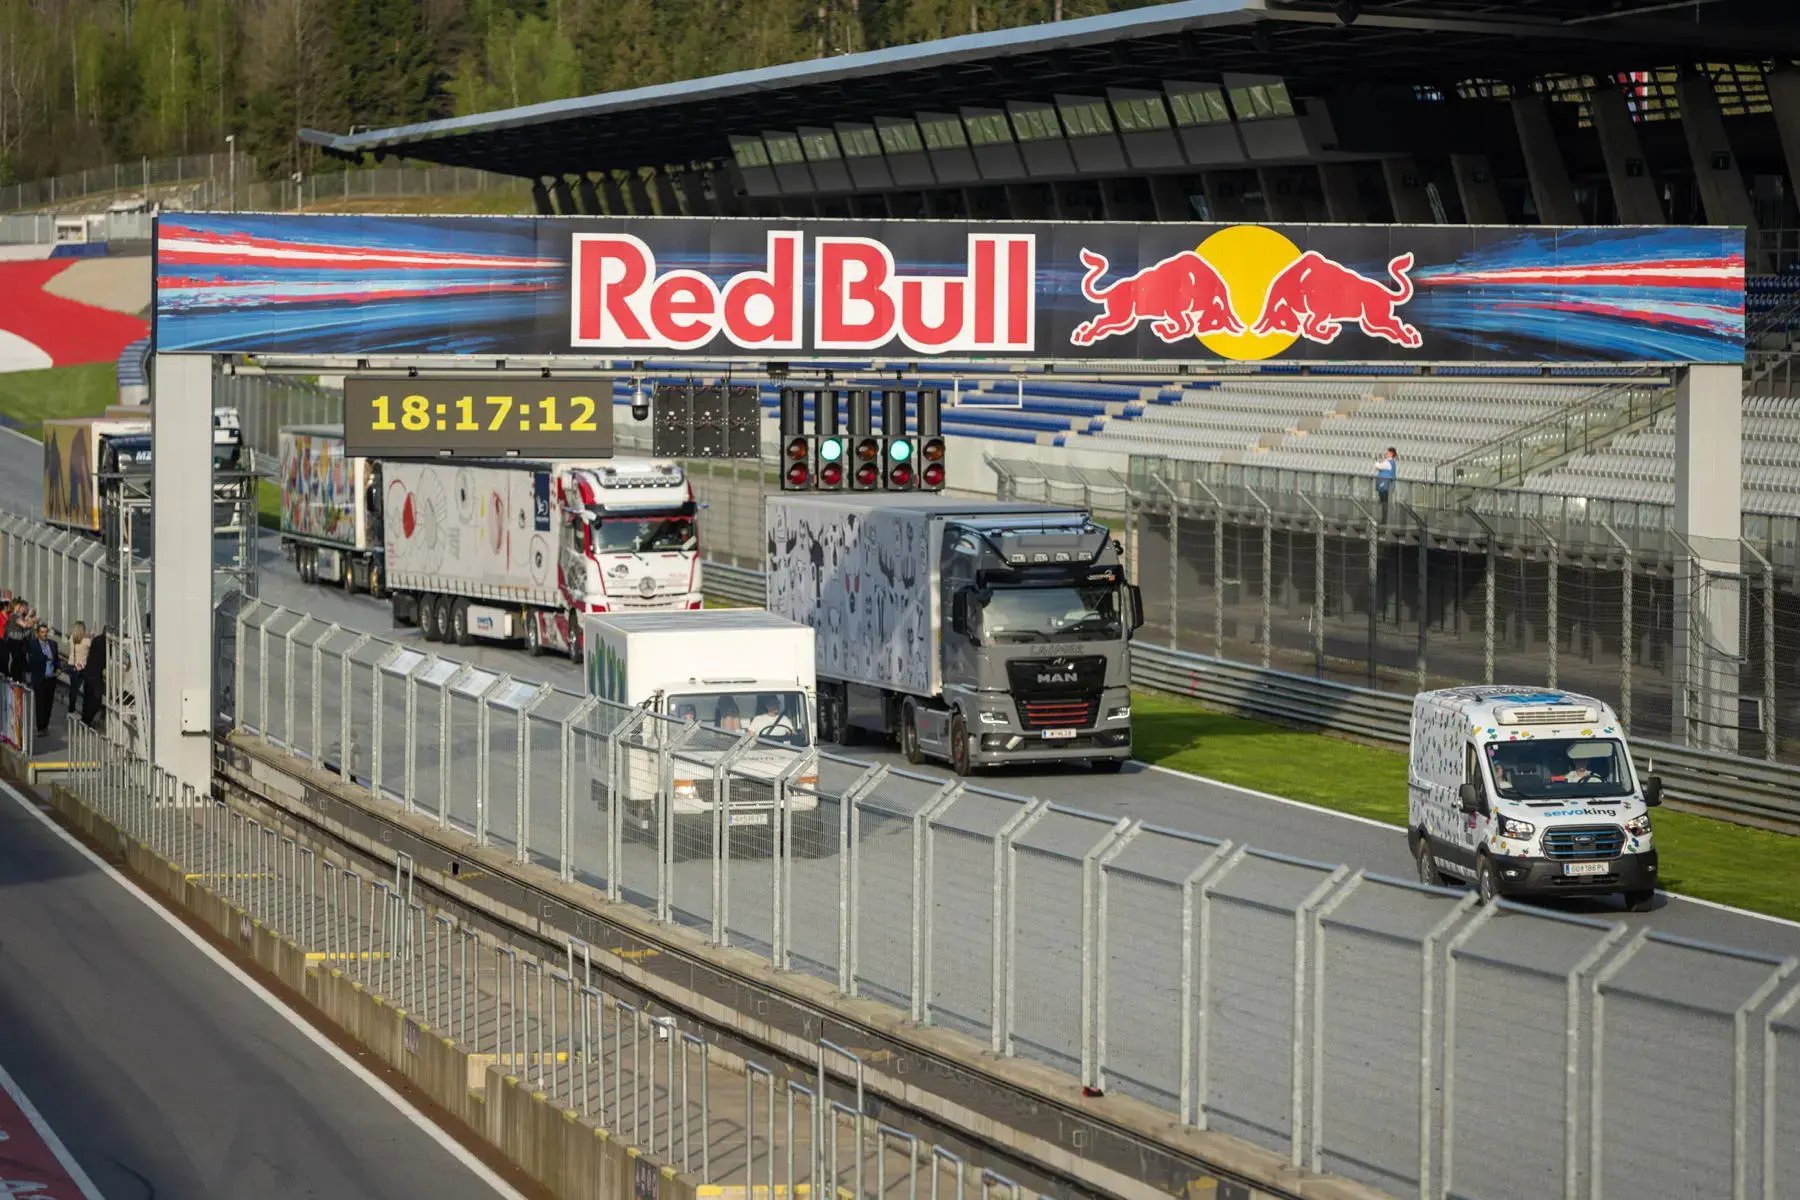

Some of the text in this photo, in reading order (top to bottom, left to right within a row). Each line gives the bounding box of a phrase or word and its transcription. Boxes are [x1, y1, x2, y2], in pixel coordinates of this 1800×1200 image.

[572, 231, 1035, 353] Red Bull
[371, 395, 597, 431] 18:17:12
[1037, 673, 1078, 683] MAN
[1544, 808, 1617, 817] servoking
